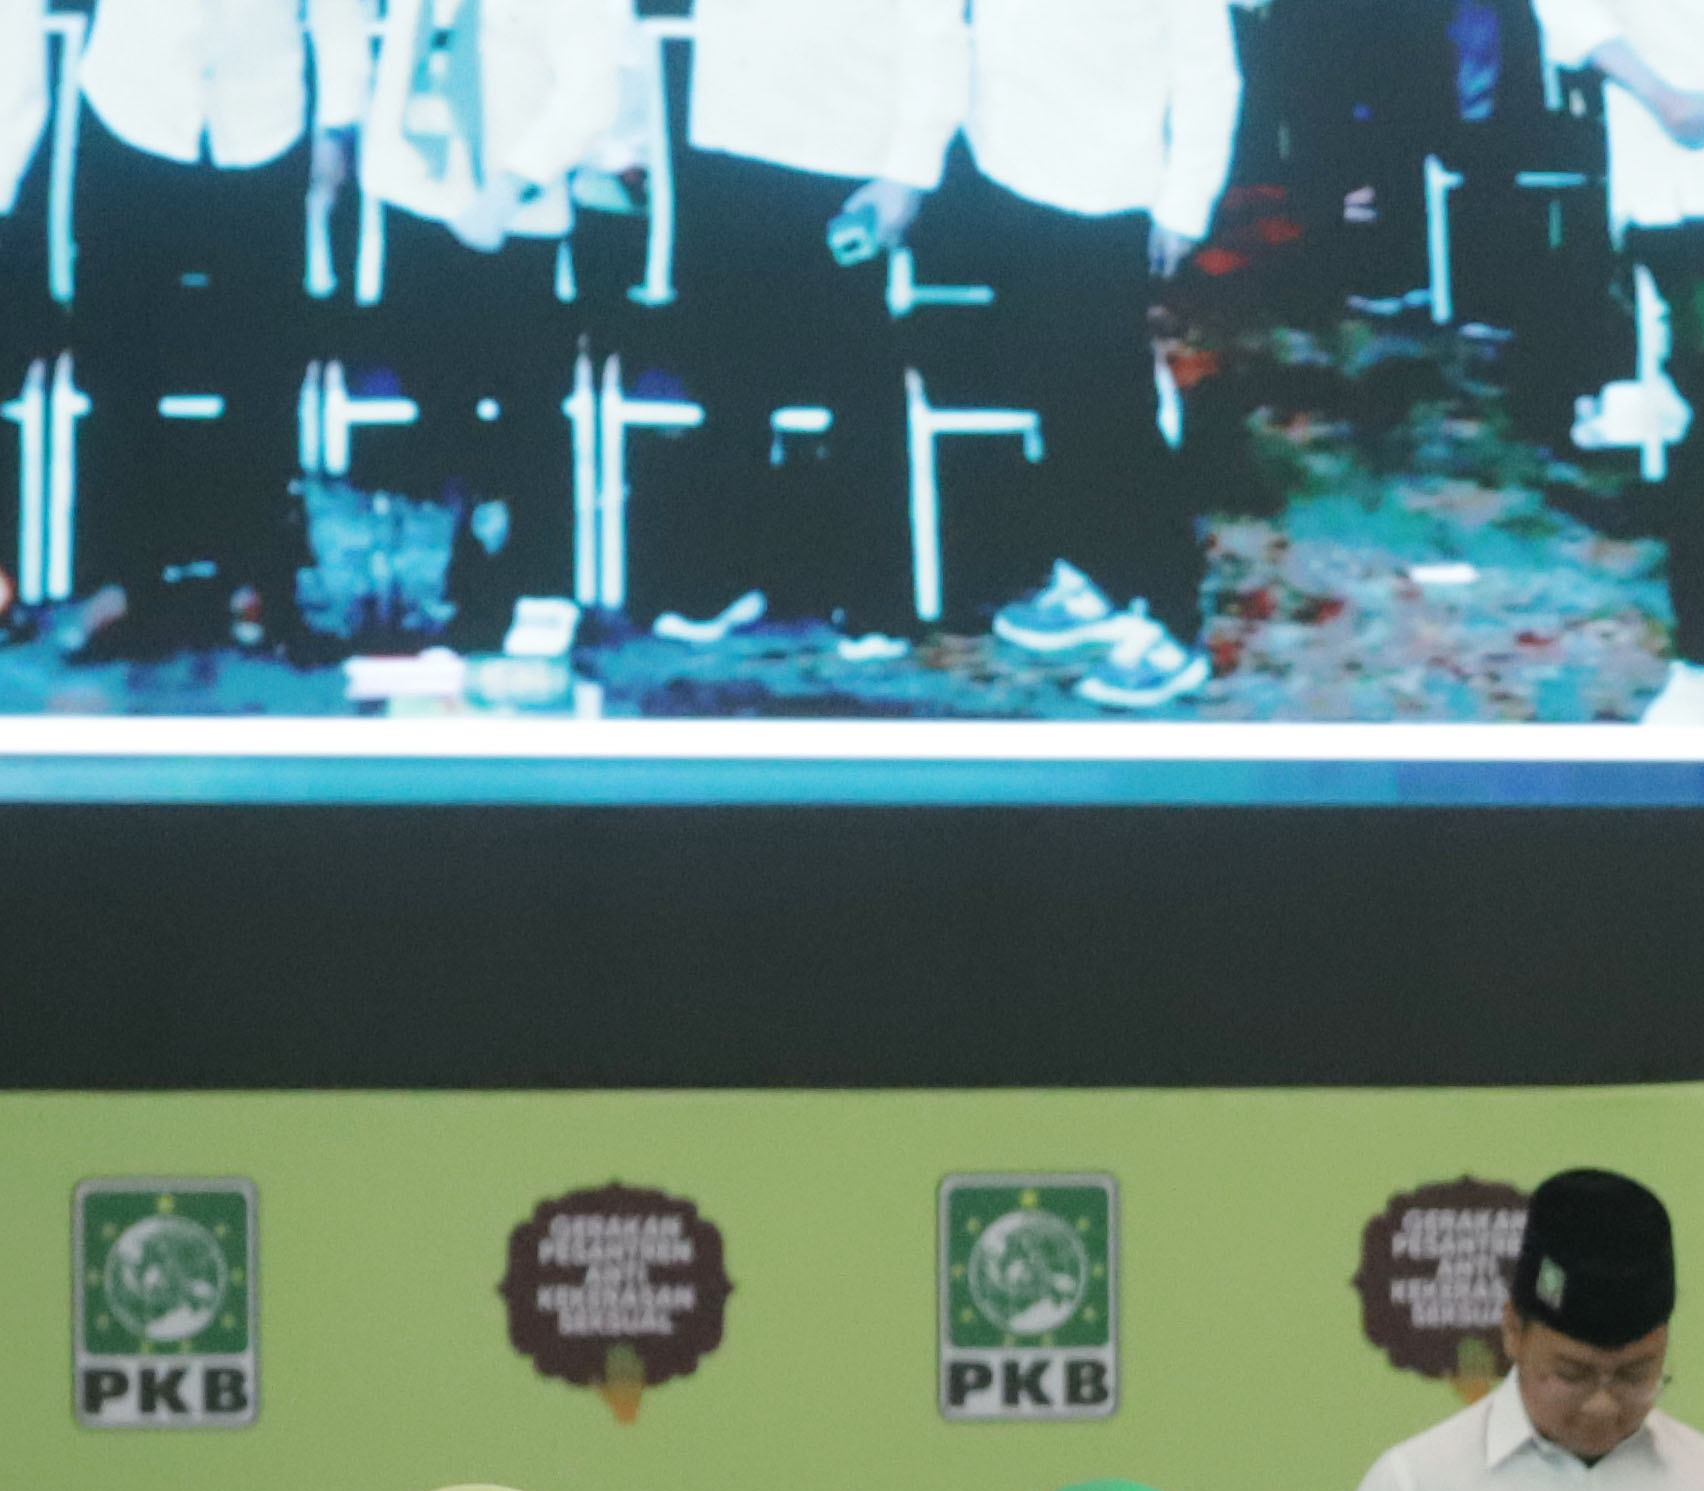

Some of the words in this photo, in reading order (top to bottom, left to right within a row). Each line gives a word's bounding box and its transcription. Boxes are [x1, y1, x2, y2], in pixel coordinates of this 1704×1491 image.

[550, 1215, 683, 1239] GERAKAN
[537, 1238, 694, 1265] PESANTREN
[1391, 1232, 1522, 1259] PESANTRE
[537, 1285, 695, 1311] KEKERASAN
[1411, 1303, 1504, 1328] SEKSUA
[84, 1368, 248, 1414] PKB
[949, 1359, 1109, 1407] PKB
